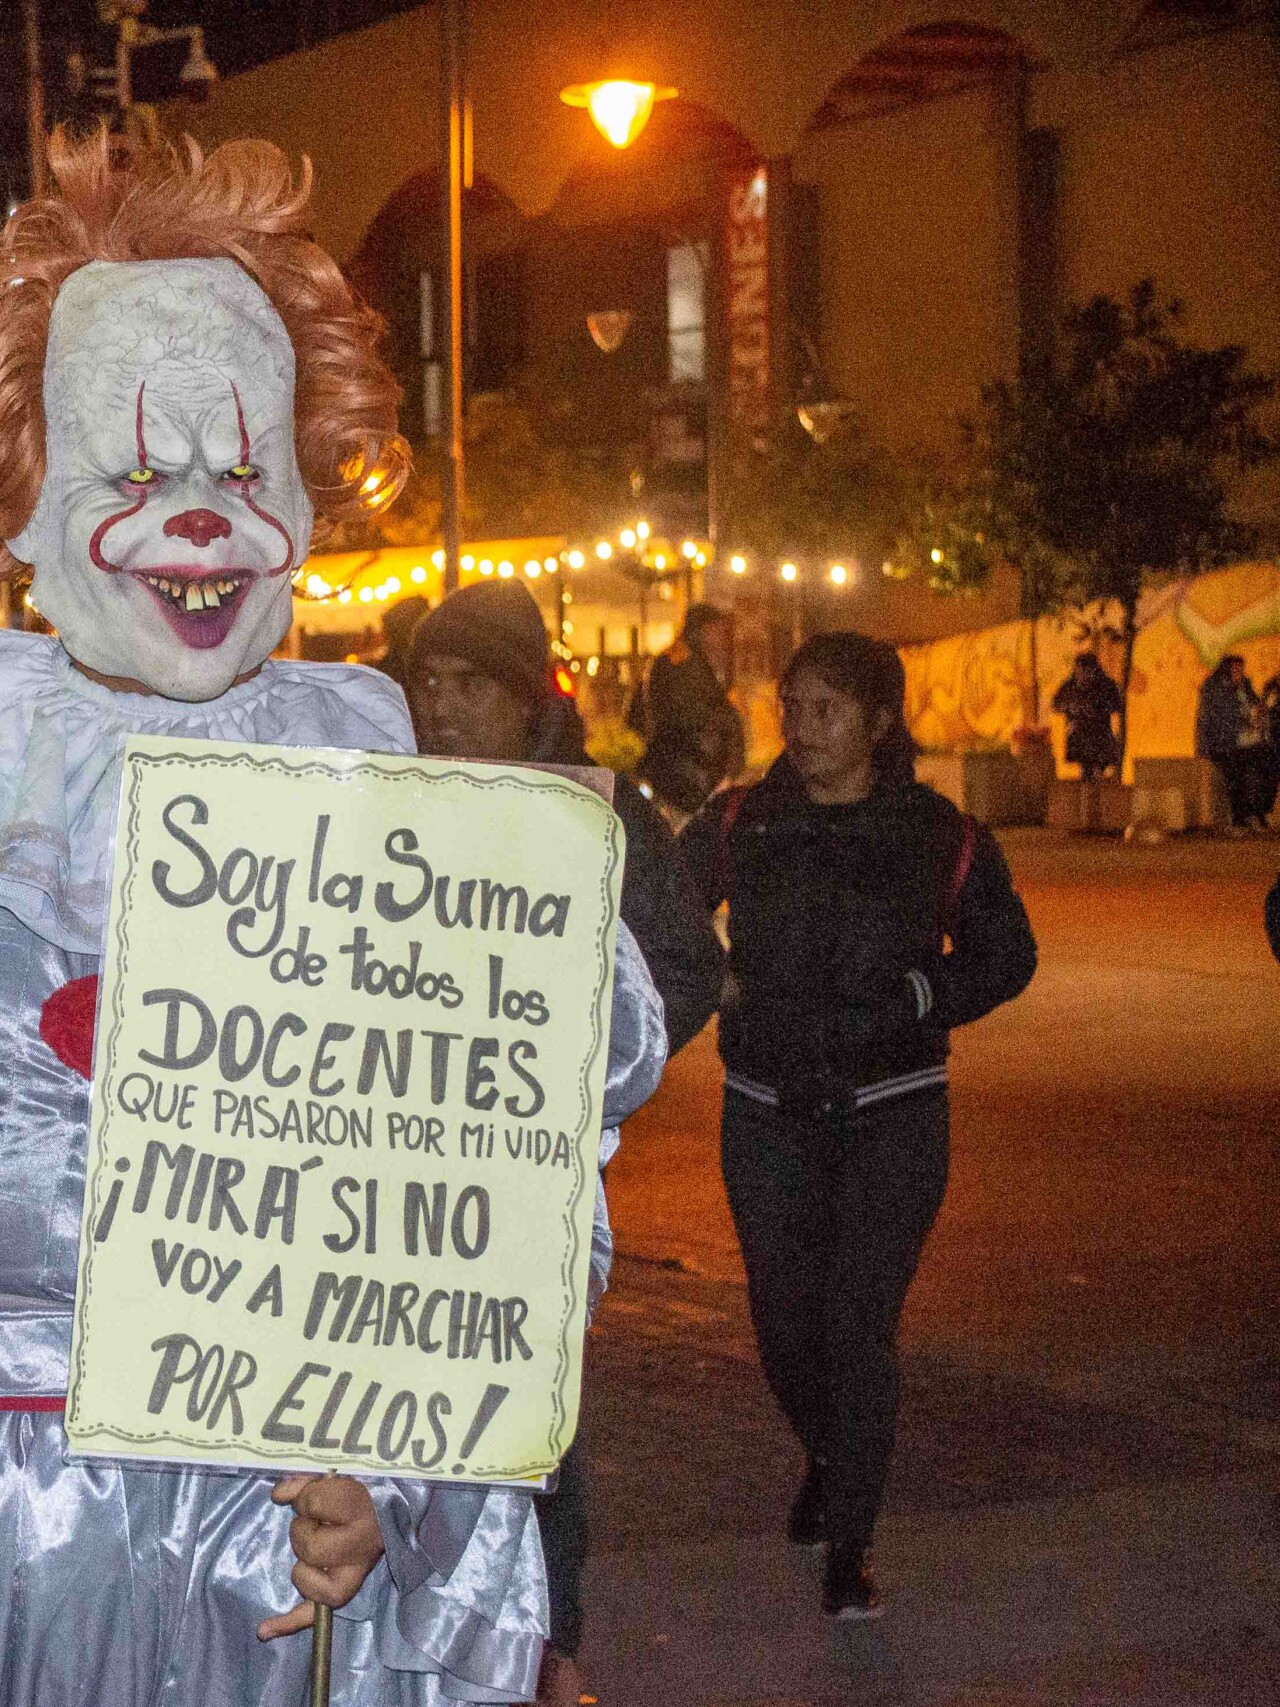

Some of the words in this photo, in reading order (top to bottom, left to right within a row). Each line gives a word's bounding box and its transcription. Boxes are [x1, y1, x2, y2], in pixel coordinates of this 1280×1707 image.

[151, 794, 297, 959] Soy
[308, 814, 363, 913] la
[375, 827, 572, 938] Suma
[270, 926, 327, 987] de
[339, 926, 463, 1008] todos
[488, 953, 551, 1027] los
[137, 987, 547, 1119] DOCENTES
[117, 1072, 198, 1130] QUE
[212, 1088, 374, 1149] PASARON
[387, 1113, 446, 1157] POR
[505, 1128, 572, 1169] VIDA
[322, 1175, 377, 1255] SI
[403, 1181, 491, 1260] NO
[151, 1238, 242, 1303] VOY
[246, 1263, 283, 1317] A
[303, 1271, 533, 1365] MARCHAR
[146, 1332, 257, 1436] POR
[259, 1361, 510, 1475] ELLOS!
